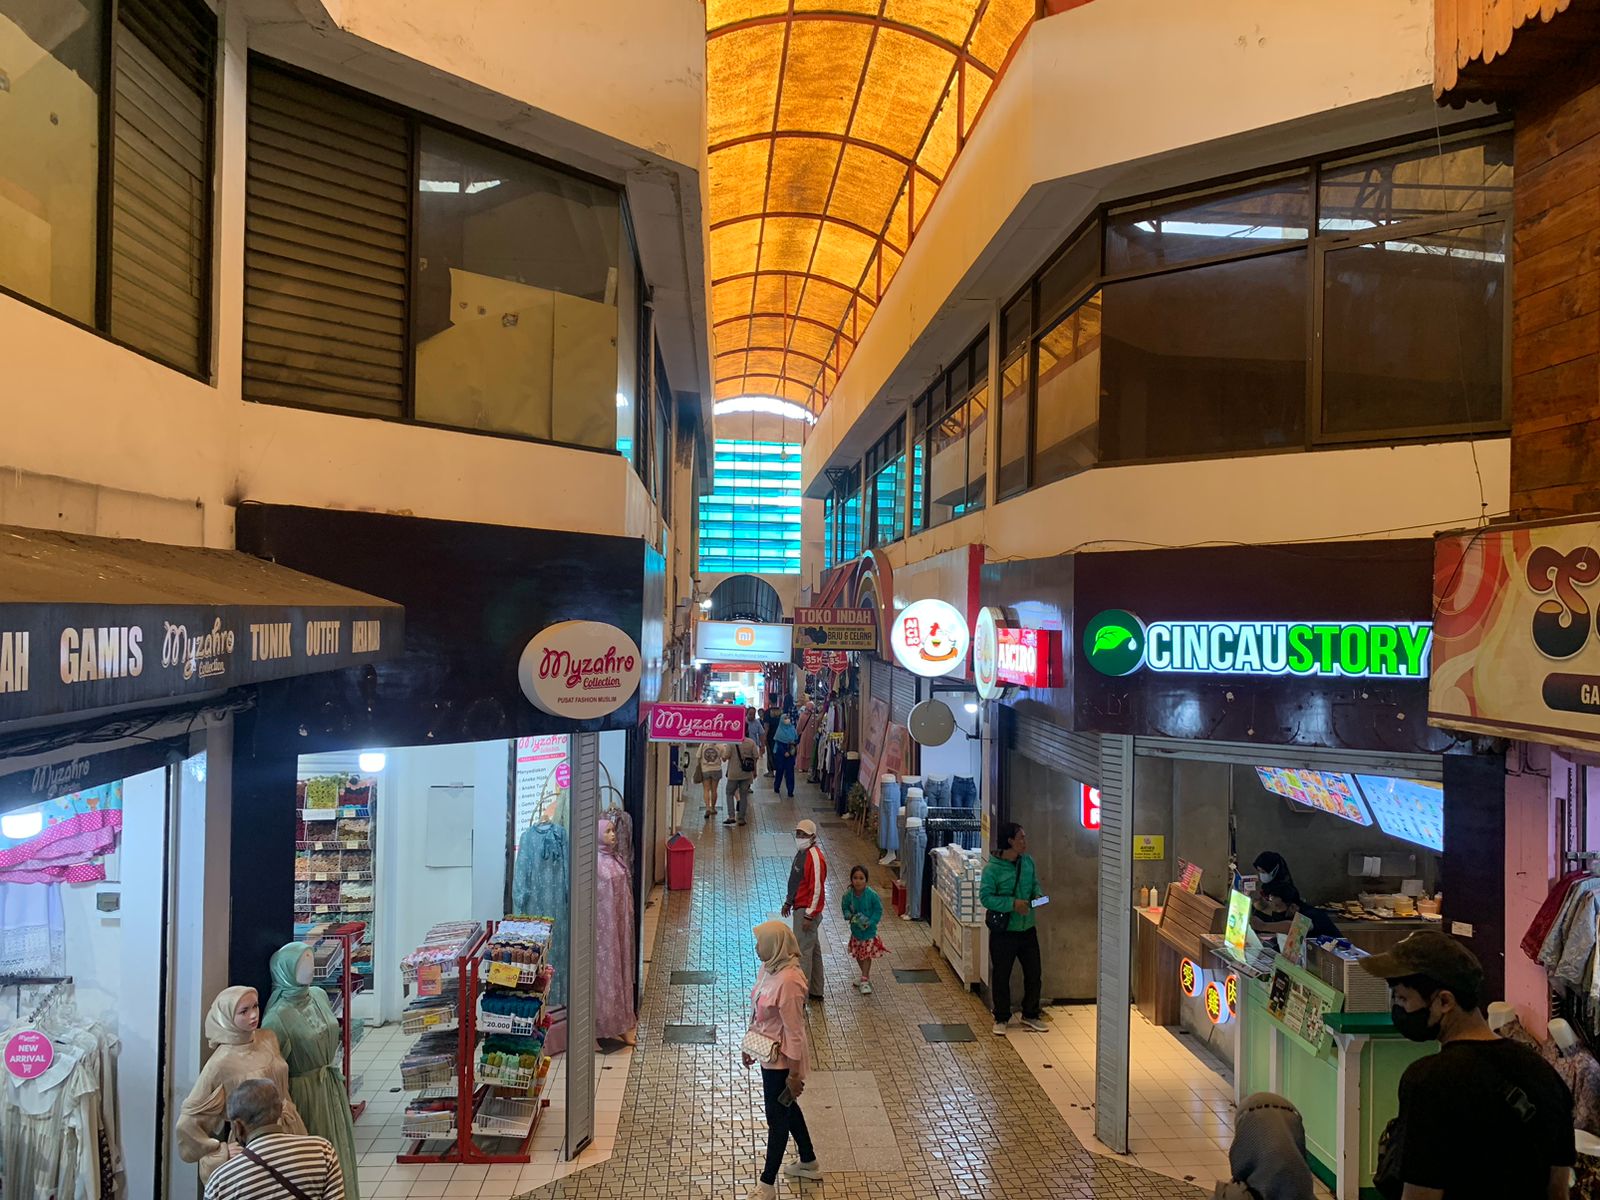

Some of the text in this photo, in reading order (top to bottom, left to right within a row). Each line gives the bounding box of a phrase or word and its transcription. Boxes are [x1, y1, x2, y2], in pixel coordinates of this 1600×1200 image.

[800, 609, 871, 624] TOKO INDAH
[162, 617, 235, 680] Myzahro
[250, 623, 292, 661] TUNIK
[306, 620, 341, 655] OUTFIT
[828, 631, 843, 640] BAJU
[849, 632, 872, 641] CELANA
[0, 631, 29, 693] AH
[60, 625, 143, 684] GAMIS
[539, 646, 635, 689] Myzahro
[583, 677, 621, 690] Collection
[574, 696, 598, 704] FASHION
[655, 709, 741, 736] Myzahro
[487, 1021, 511, 1029] 20.000
